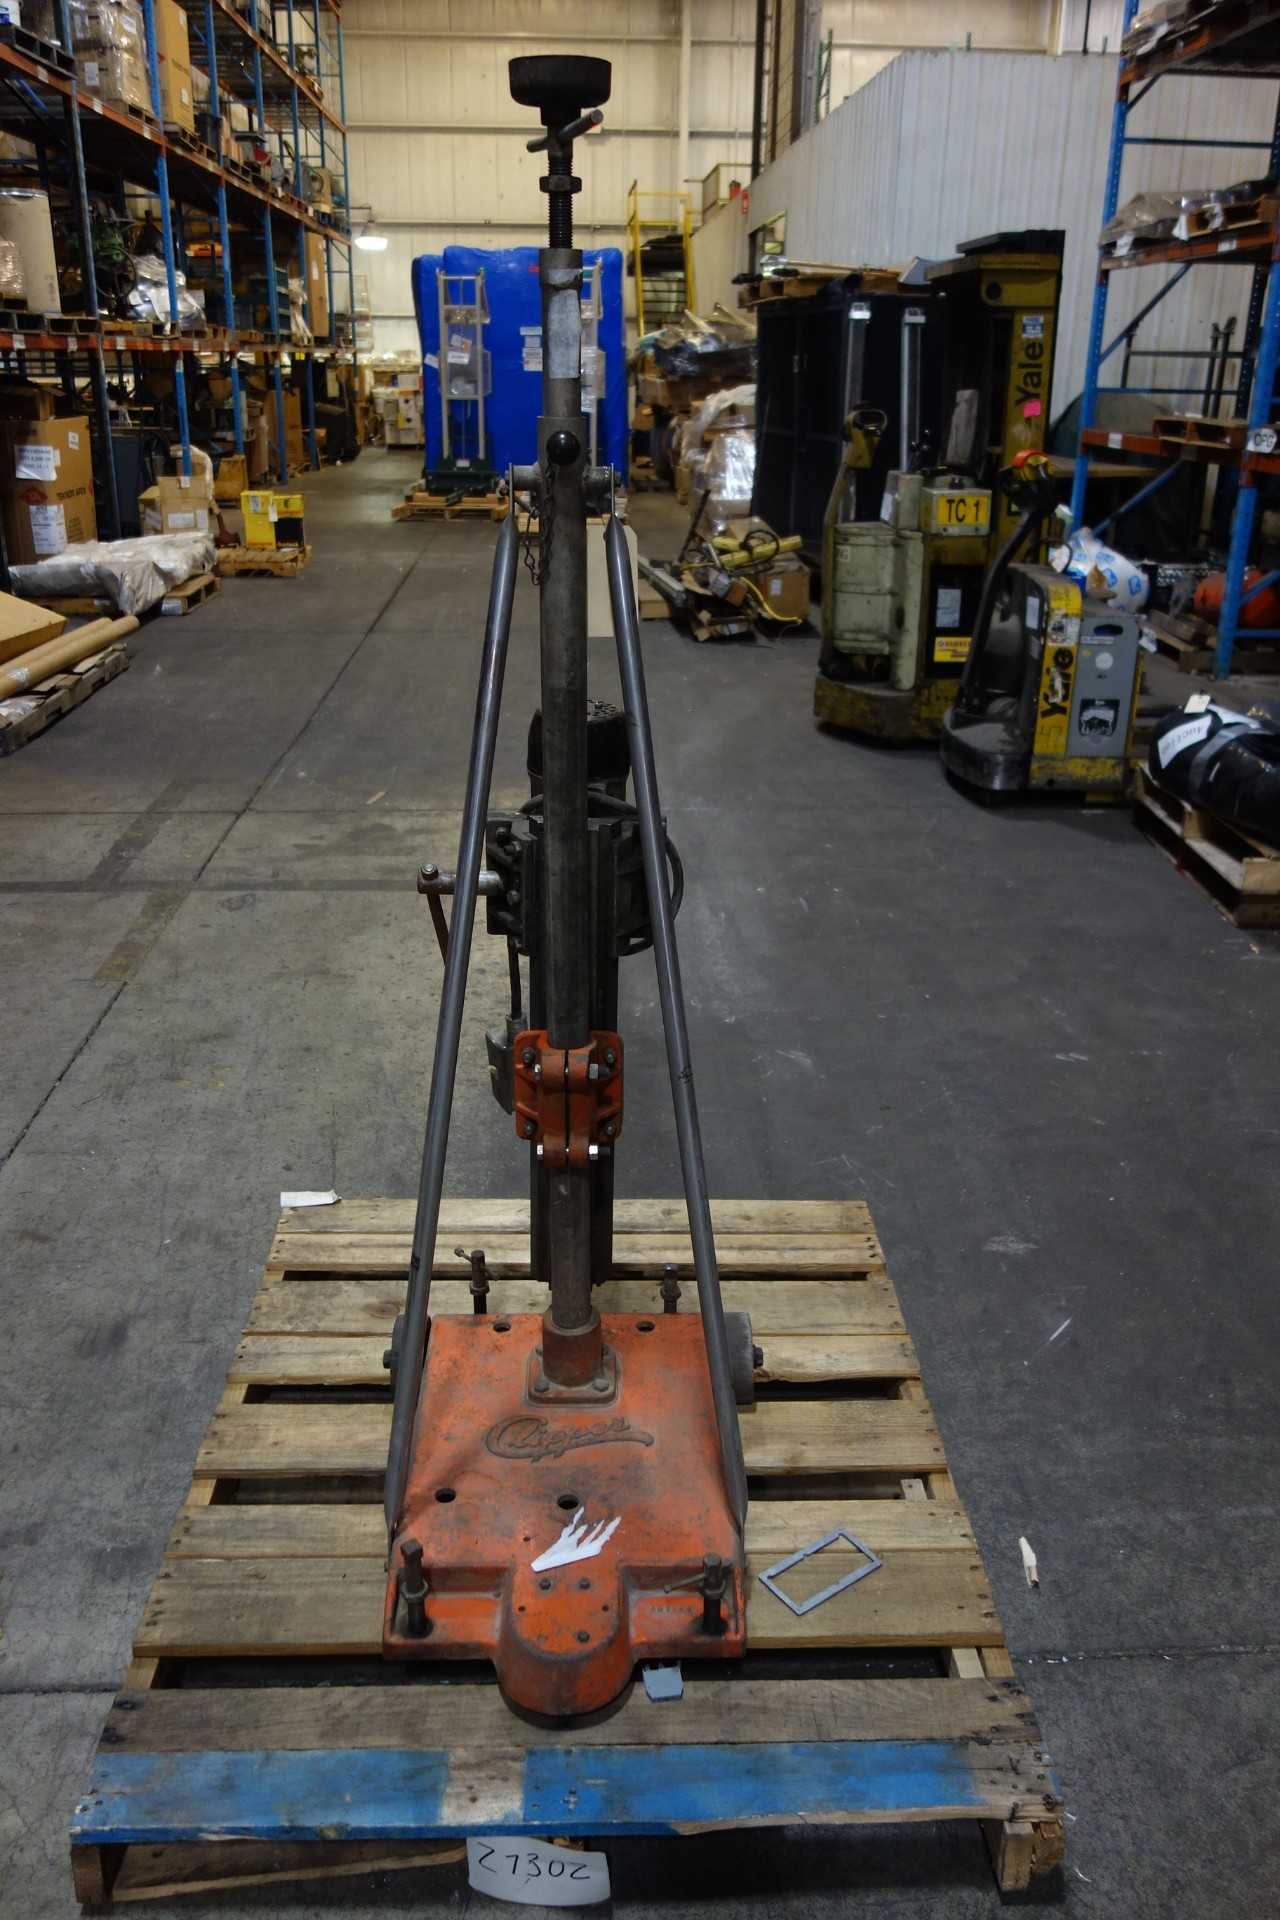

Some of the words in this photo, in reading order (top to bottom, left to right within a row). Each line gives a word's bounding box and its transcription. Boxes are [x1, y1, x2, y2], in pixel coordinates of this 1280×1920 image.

[1015, 341, 1043, 406] Yale
[946, 498, 967, 523] TC
[973, 499, 981, 522] 1
